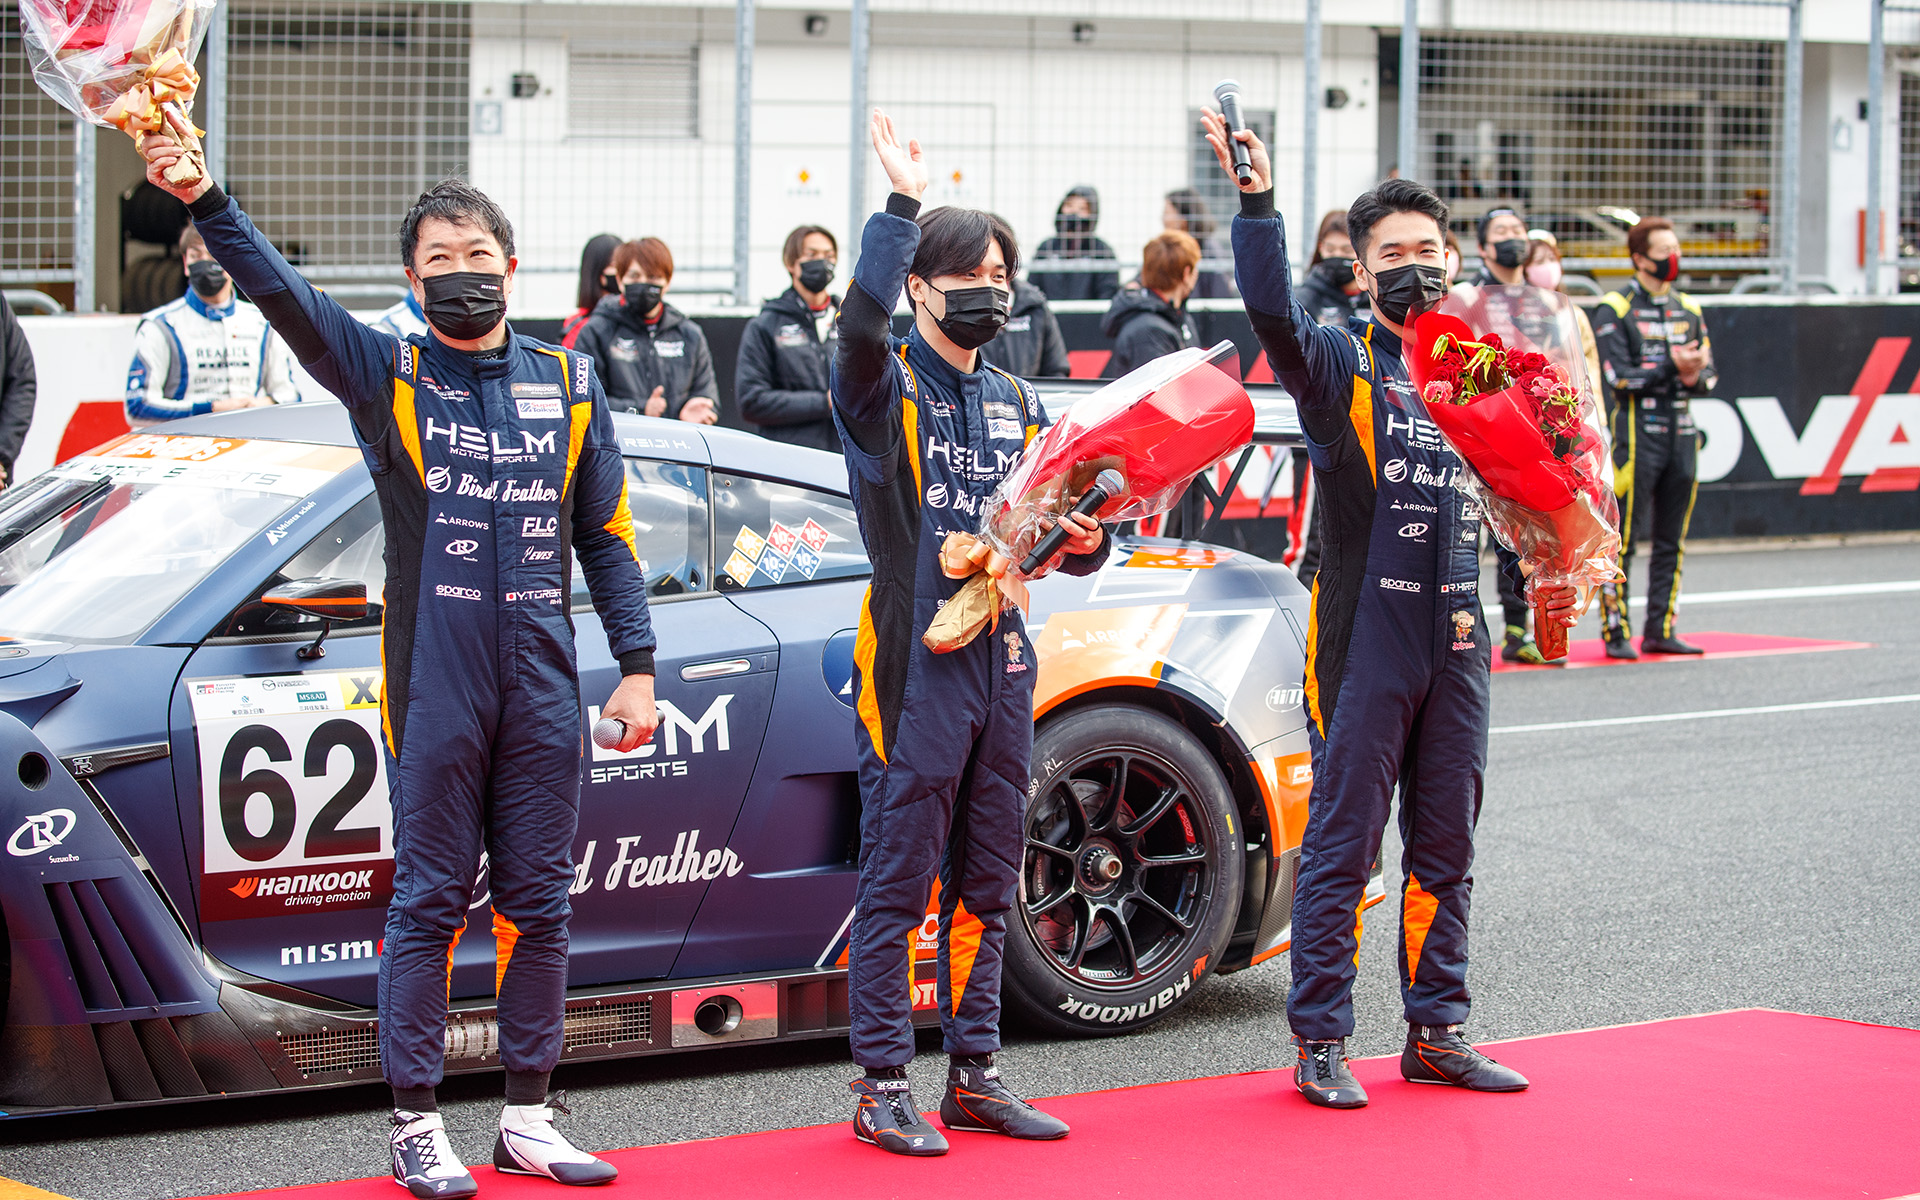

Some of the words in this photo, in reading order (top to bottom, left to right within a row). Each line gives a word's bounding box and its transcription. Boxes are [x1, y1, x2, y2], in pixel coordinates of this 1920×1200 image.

[425, 417, 557, 455] HELM
[450, 447, 489, 461] MOTOR
[493, 455, 537, 463] SPORTS
[927, 436, 1021, 473] HELM
[1407, 440, 1440, 452] MOTOR
[1412, 464, 1446, 487] Bird
[501, 479, 558, 502] Feather
[1403, 502, 1438, 514] ARROWS
[449, 516, 489, 530] ARROWS
[436, 584, 482, 600] sparco
[1380, 577, 1421, 593] sparco
[300, 693, 325, 701] MS&AD
[350, 677, 378, 705] X
[590, 760, 688, 784] SPORTS
[219, 718, 381, 862] 62
[604, 829, 744, 892] Feather
[284, 895, 322, 906] driving
[325, 891, 371, 903] emotion
[281, 938, 384, 966] nism
[876, 1080, 909, 1091] sparco
